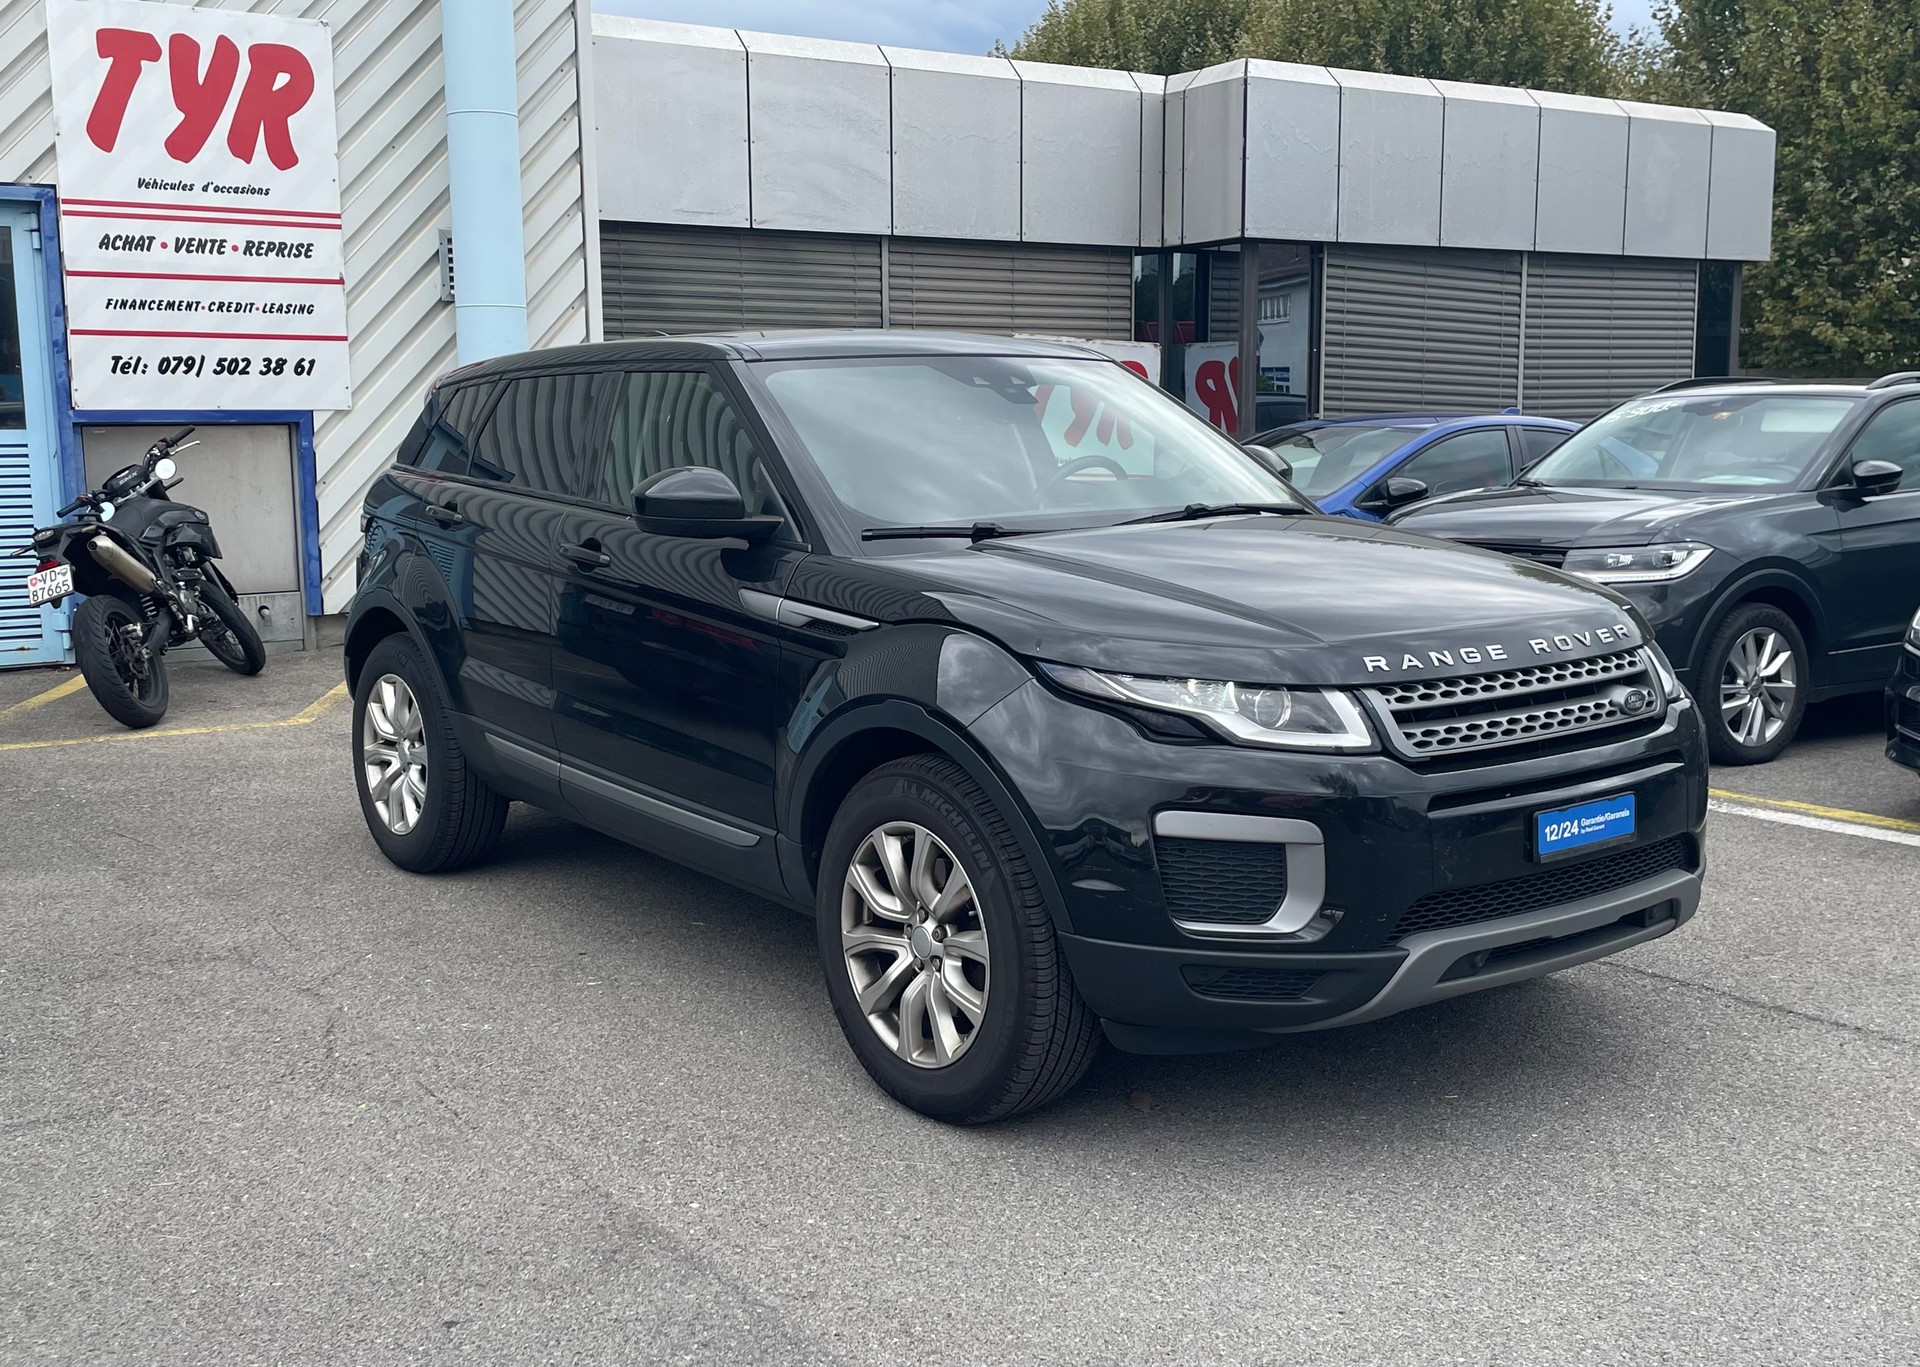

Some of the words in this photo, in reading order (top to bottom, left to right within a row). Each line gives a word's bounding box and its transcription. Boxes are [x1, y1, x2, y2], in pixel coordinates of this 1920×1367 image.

[86, 28, 315, 171] TYR
[137, 177, 195, 193] Véhicules
[202, 181, 271, 197] d'occasions
[98, 233, 157, 253] ACHAT
[174, 236, 228, 256] VENTE
[242, 240, 315, 259] REPRISE
[105, 298, 202, 312] FINANCEMENT
[207, 301, 256, 314] CREDIT
[261, 302, 315, 316] LEASING
[110, 355, 149, 375] Tél:
[212, 357, 252, 376] 502
[258, 357, 288, 376] 38
[293, 357, 316, 377] 61
[40, 569, 58, 585] VD
[31, 579, 71, 602] 87665
[1362, 643, 1508, 673] RANGE
[1528, 623, 1631, 655] ROVER
[920, 787, 994, 871] MICHELIN
[1580, 808, 1630, 827] Garantie/Garanzia
[1544, 819, 1579, 842] 12/24
